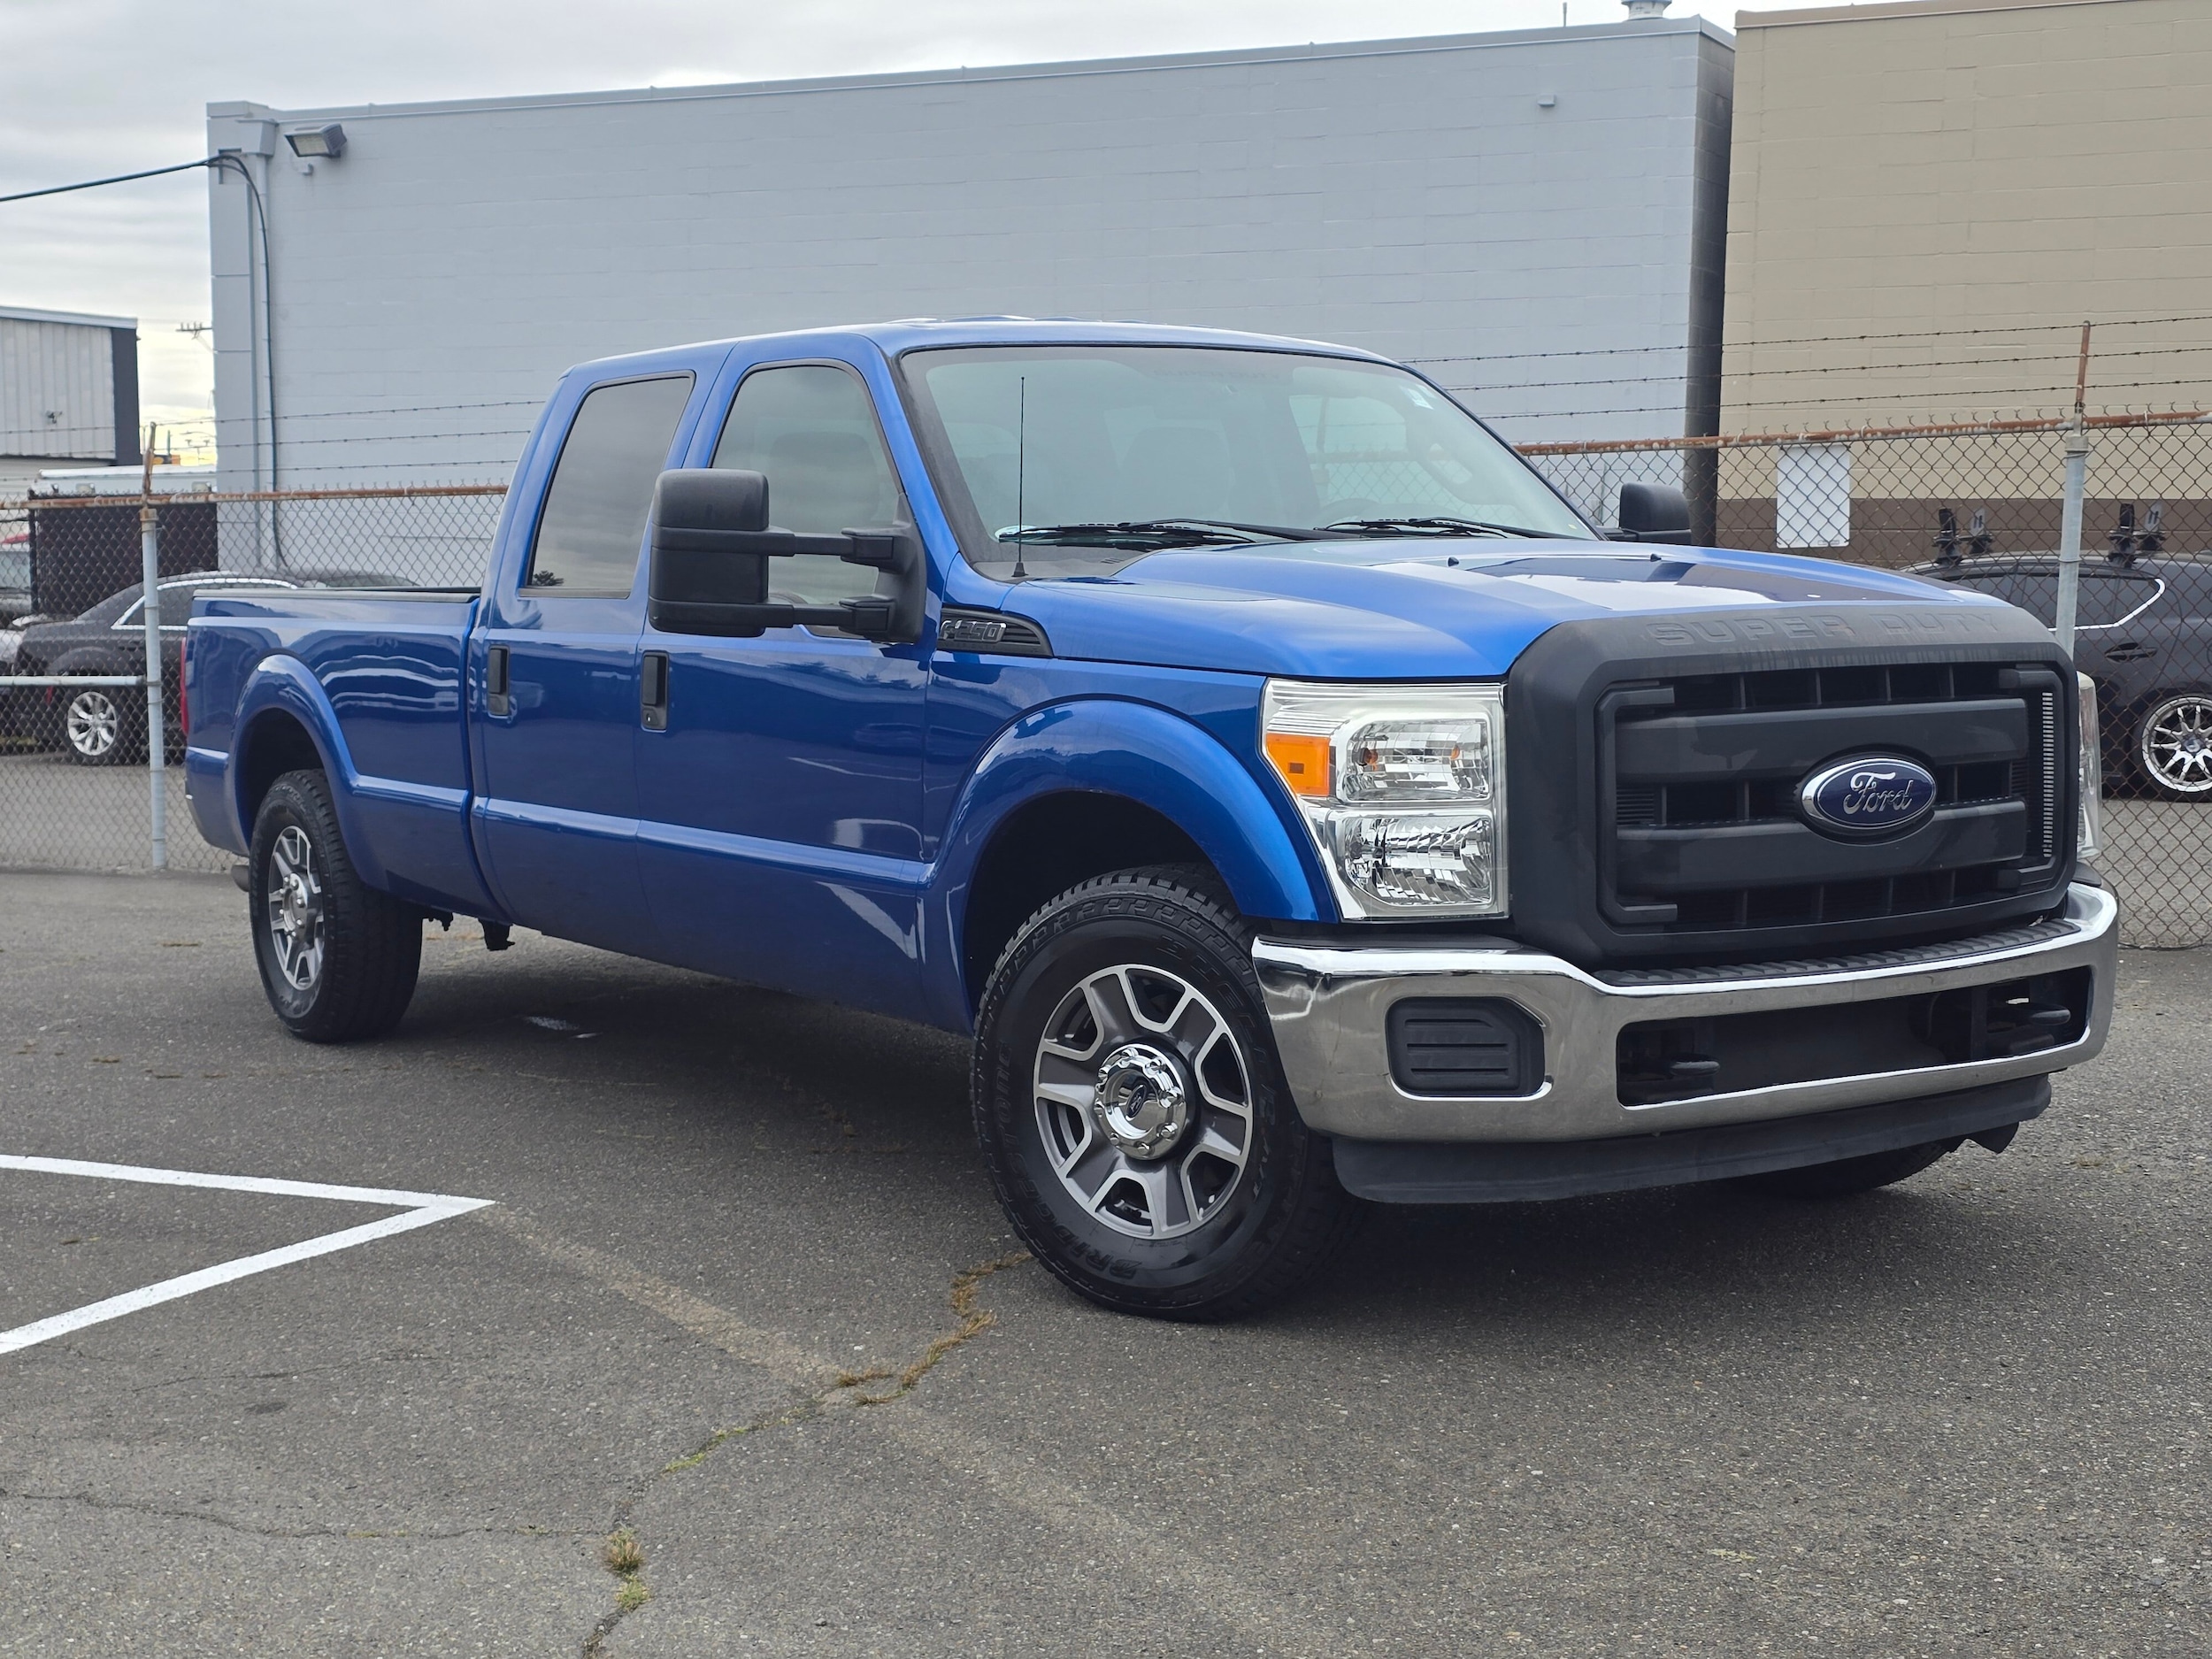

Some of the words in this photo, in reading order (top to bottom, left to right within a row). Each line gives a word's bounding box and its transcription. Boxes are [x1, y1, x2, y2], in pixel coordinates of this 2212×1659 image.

[1647, 613, 1855, 647] SUPER
[1869, 612, 2000, 635] DUTY
[1843, 772, 1914, 815] Ford
[994, 1040, 1142, 1280] BRIDGESTONE
